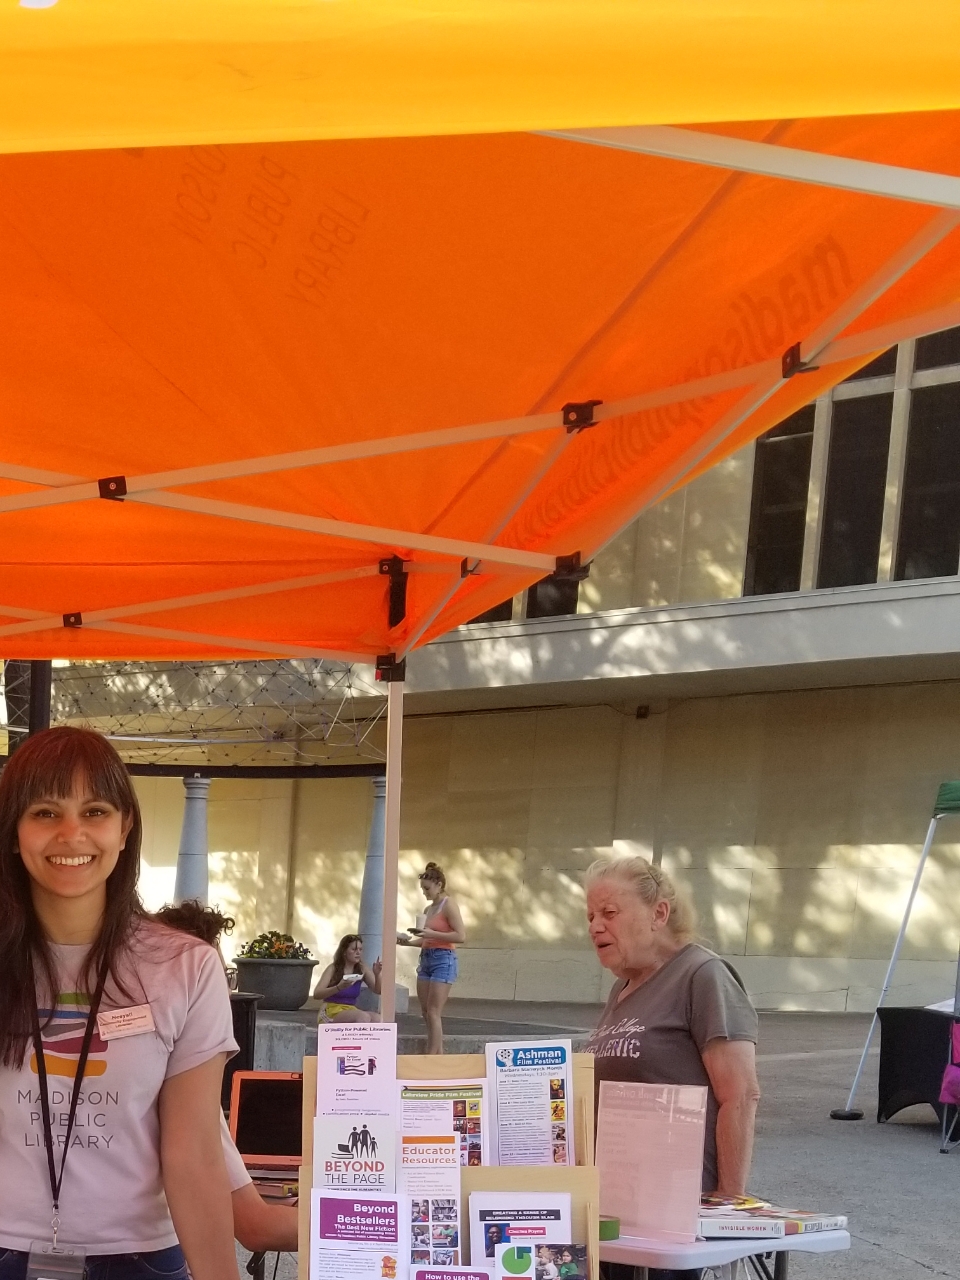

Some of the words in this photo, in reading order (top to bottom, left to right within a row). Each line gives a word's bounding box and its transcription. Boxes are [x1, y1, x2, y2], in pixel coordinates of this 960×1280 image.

[517, 1049, 562, 1060] Ashman
[16, 1089, 120, 1106] MADISON
[30, 1112, 107, 1128] PUBLIC
[24, 1132, 115, 1150] LIBRARY
[402, 1146, 456, 1155] Educator
[324, 1161, 384, 1172] BEYOND
[324, 1174, 348, 1184] THE
[354, 1174, 384, 1184] PAGE
[354, 1204, 395, 1214] Beyond
[337, 1214, 396, 1226] Bestsellers
